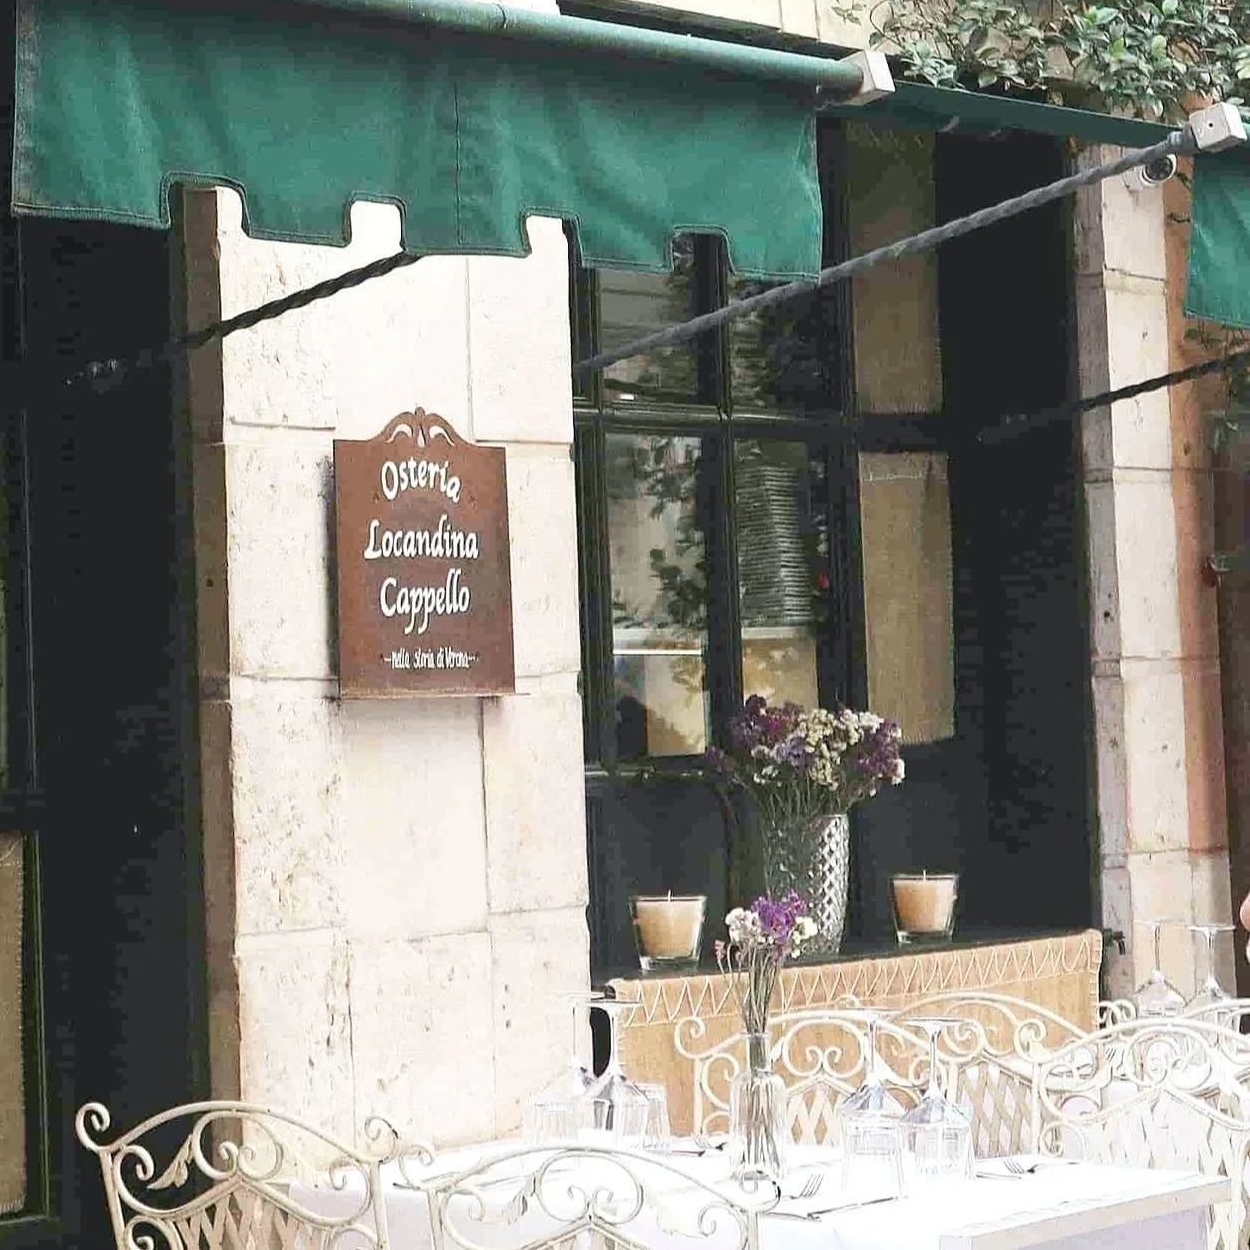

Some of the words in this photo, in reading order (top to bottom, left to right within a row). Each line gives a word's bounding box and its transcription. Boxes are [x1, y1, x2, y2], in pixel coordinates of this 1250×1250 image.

[381, 457, 462, 503] Osteria
[363, 514, 479, 560] Locandina
[380, 568, 470, 635] Cappello
